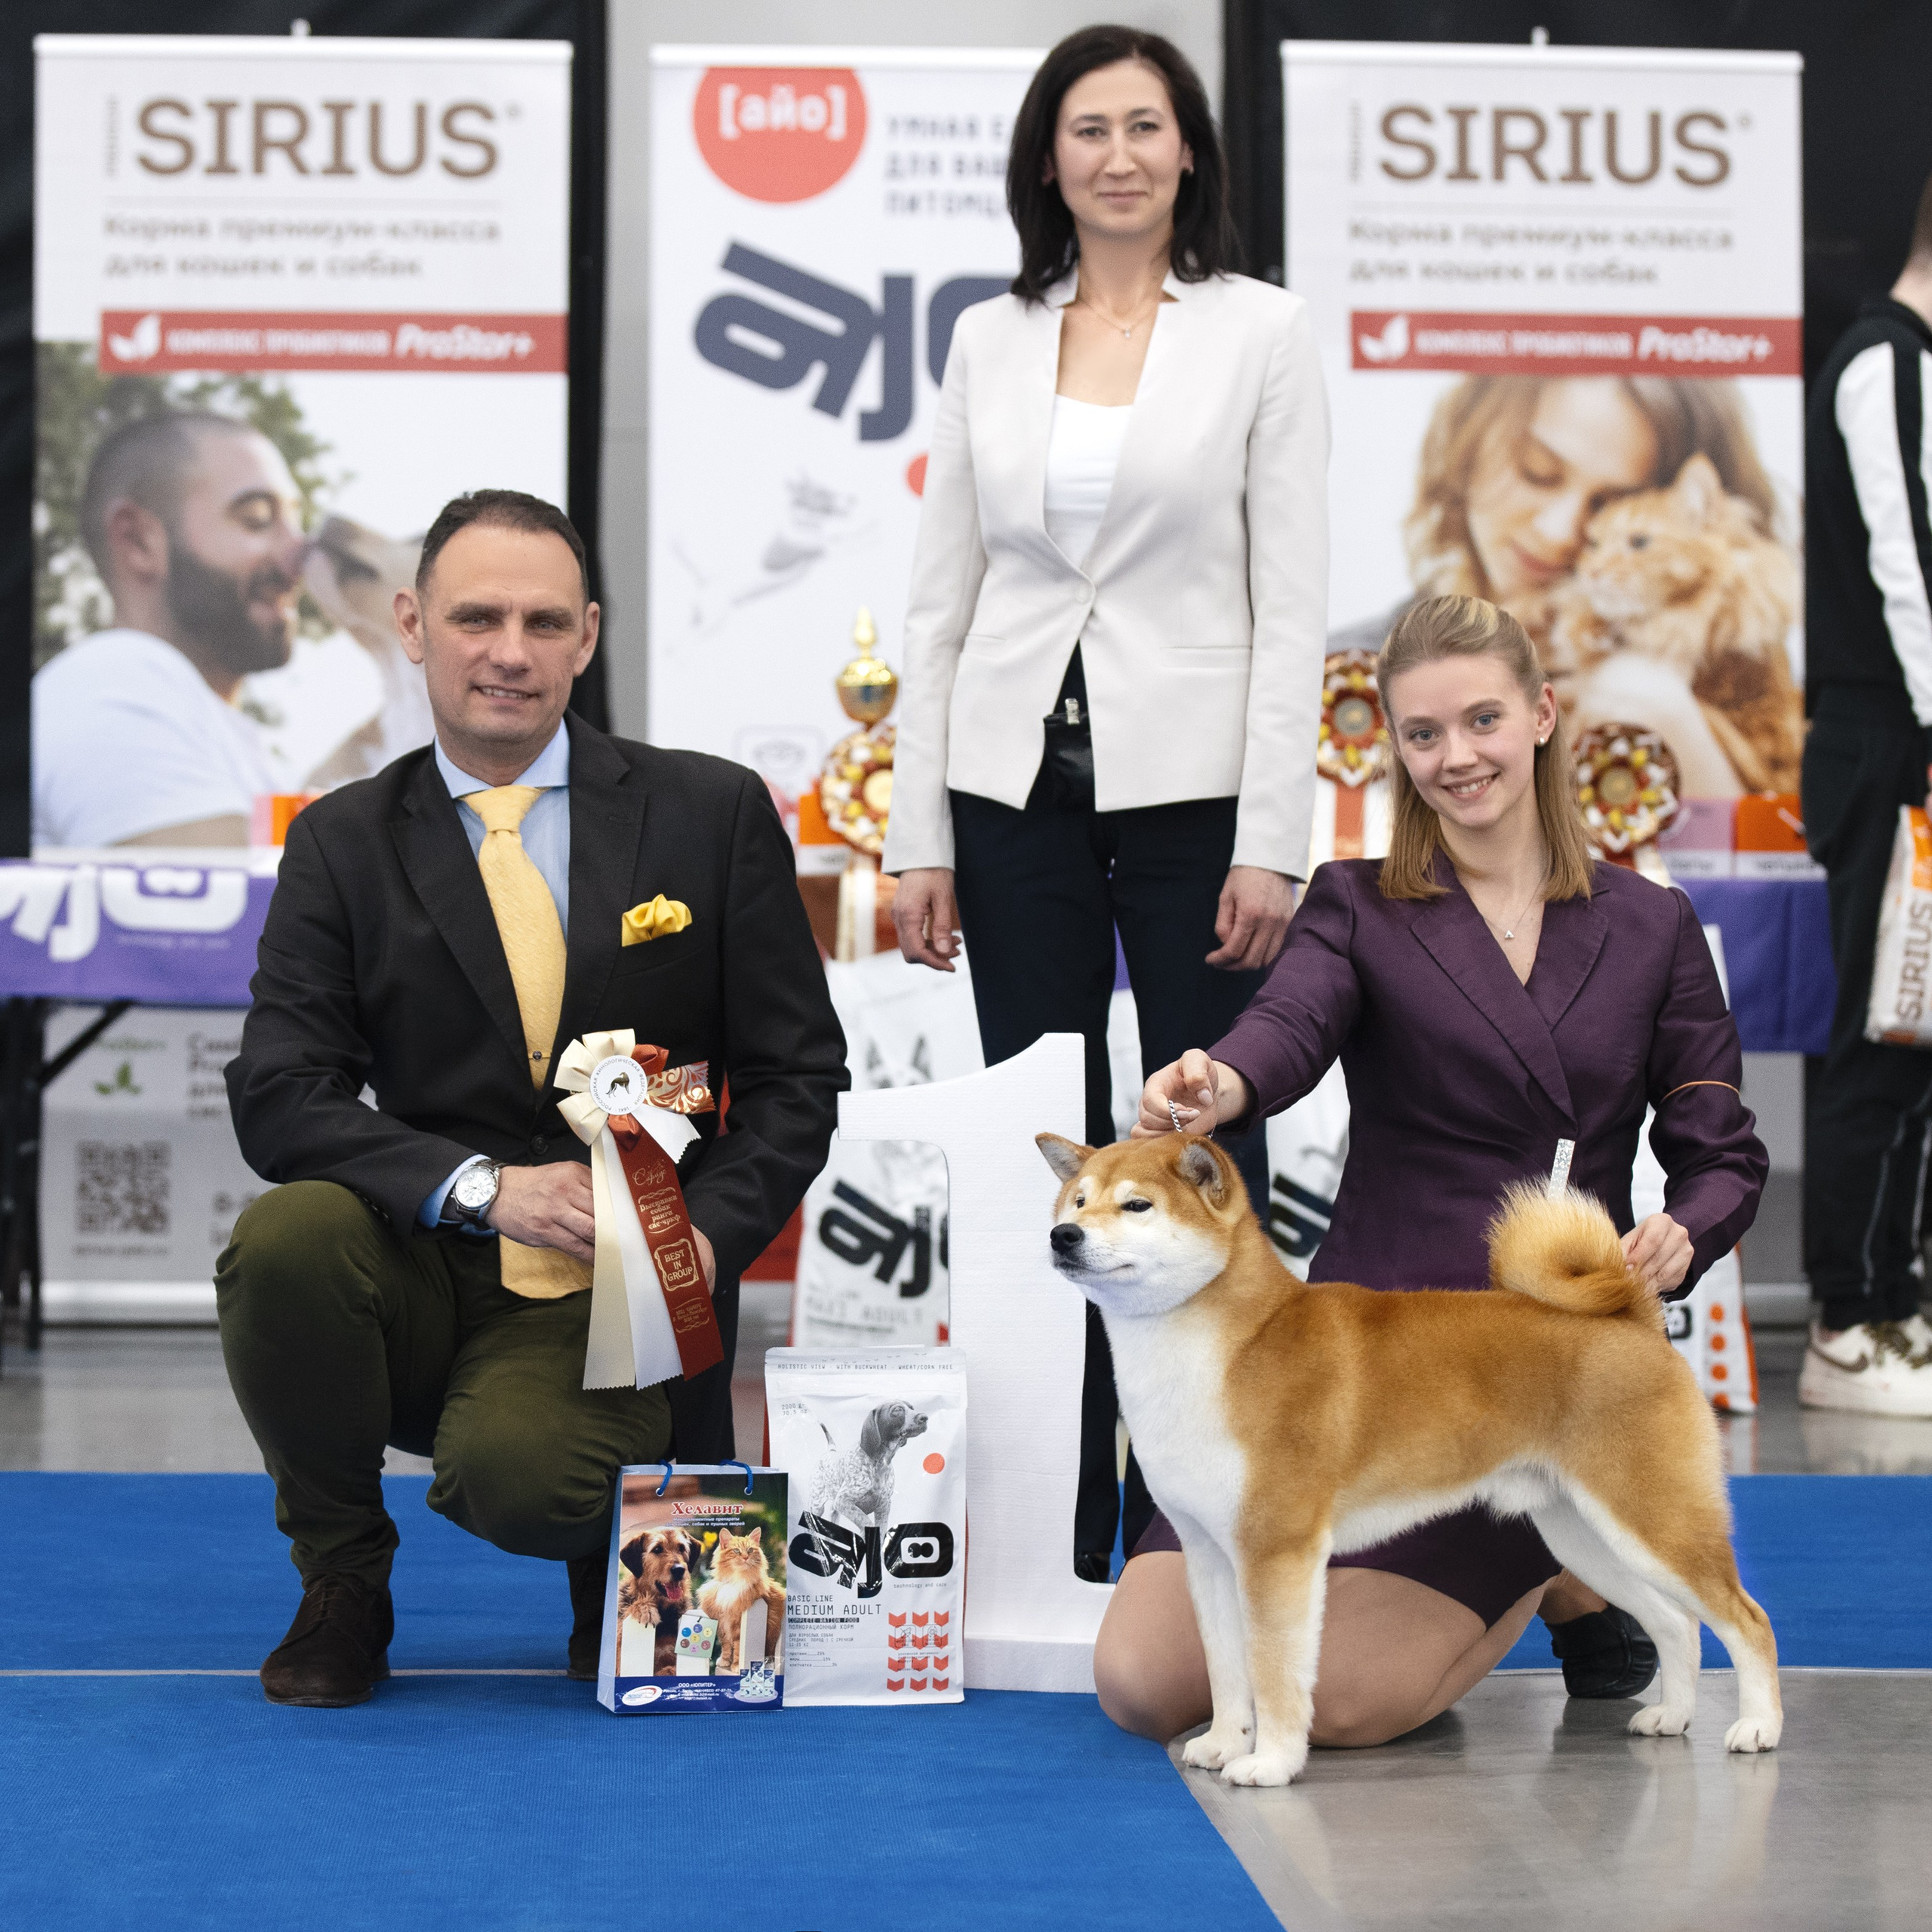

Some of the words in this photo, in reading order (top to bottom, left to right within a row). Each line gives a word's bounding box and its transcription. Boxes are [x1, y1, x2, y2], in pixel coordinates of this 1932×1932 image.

[137, 97, 499, 179] SIRIUS
[1380, 103, 1730, 187] SIRIUS
[104, 217, 210, 242] Корма
[1349, 221, 1452, 248] Корма
[106, 253, 165, 278] для
[176, 256, 285, 275] кошек
[295, 257, 316, 275] и
[327, 250, 422, 277] собак
[1349, 259, 1408, 284] для
[1419, 261, 1524, 281] кошек
[1534, 263, 1555, 281] и
[1564, 257, 1657, 284] собак
[1894, 900, 1932, 1020] SIRIUS
[596, 1058, 640, 1076] КИНОЛОГИЧЕСКАЯ
[593, 1077, 612, 1111] РОССИЙСКАЯ
[634, 1073, 646, 1106] ФЕДЕРАЦИЯ
[652, 1211, 674, 1223] ранга
[664, 1249, 685, 1263] BEST
[673, 1260, 682, 1270] IN
[667, 1266, 693, 1282] GROUP
[672, 1501, 744, 1515] Хелавит
[787, 1604, 834, 1615] MEDIUM
[843, 1604, 881, 1615] ADULT
